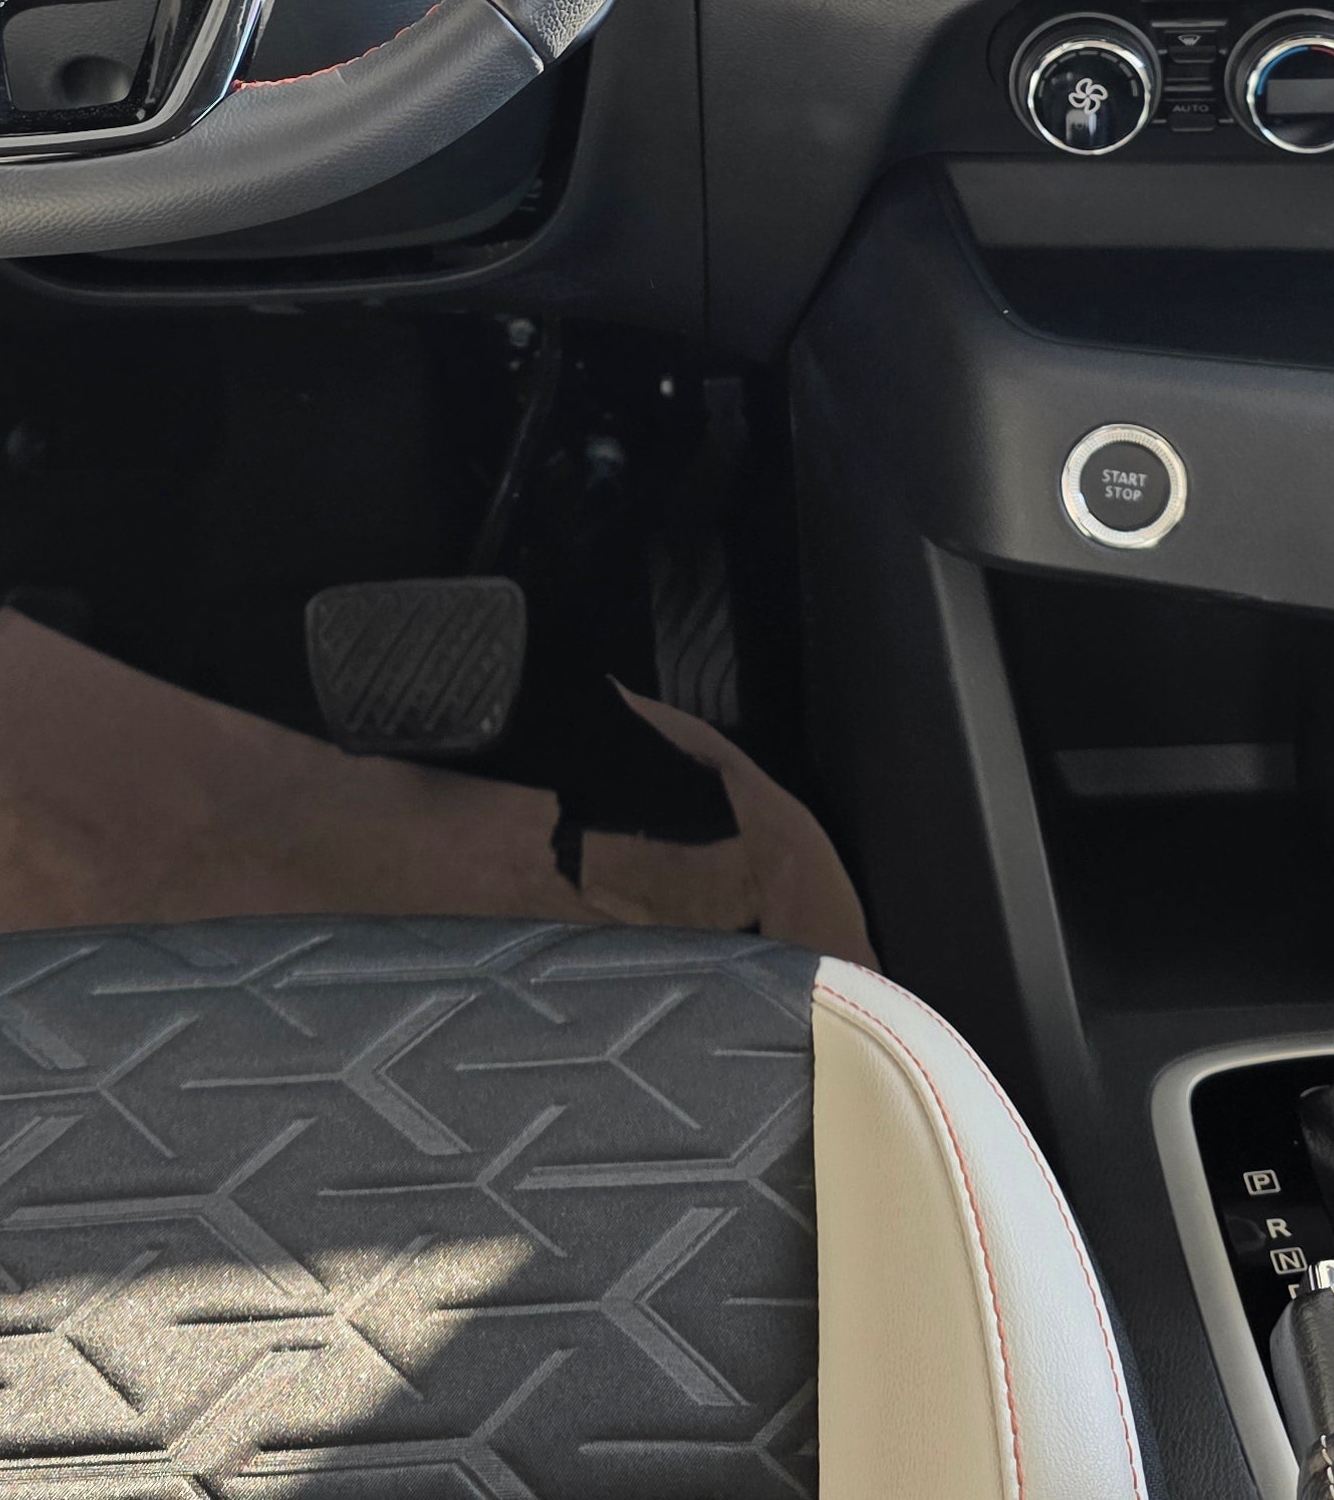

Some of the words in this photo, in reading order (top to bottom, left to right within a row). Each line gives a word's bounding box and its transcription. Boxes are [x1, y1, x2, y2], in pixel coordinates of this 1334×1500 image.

[1172, 104, 1210, 113] AUTO
[1101, 469, 1148, 487] START
[1104, 485, 1142, 502] STOP
[1266, 1218, 1293, 1239] R
